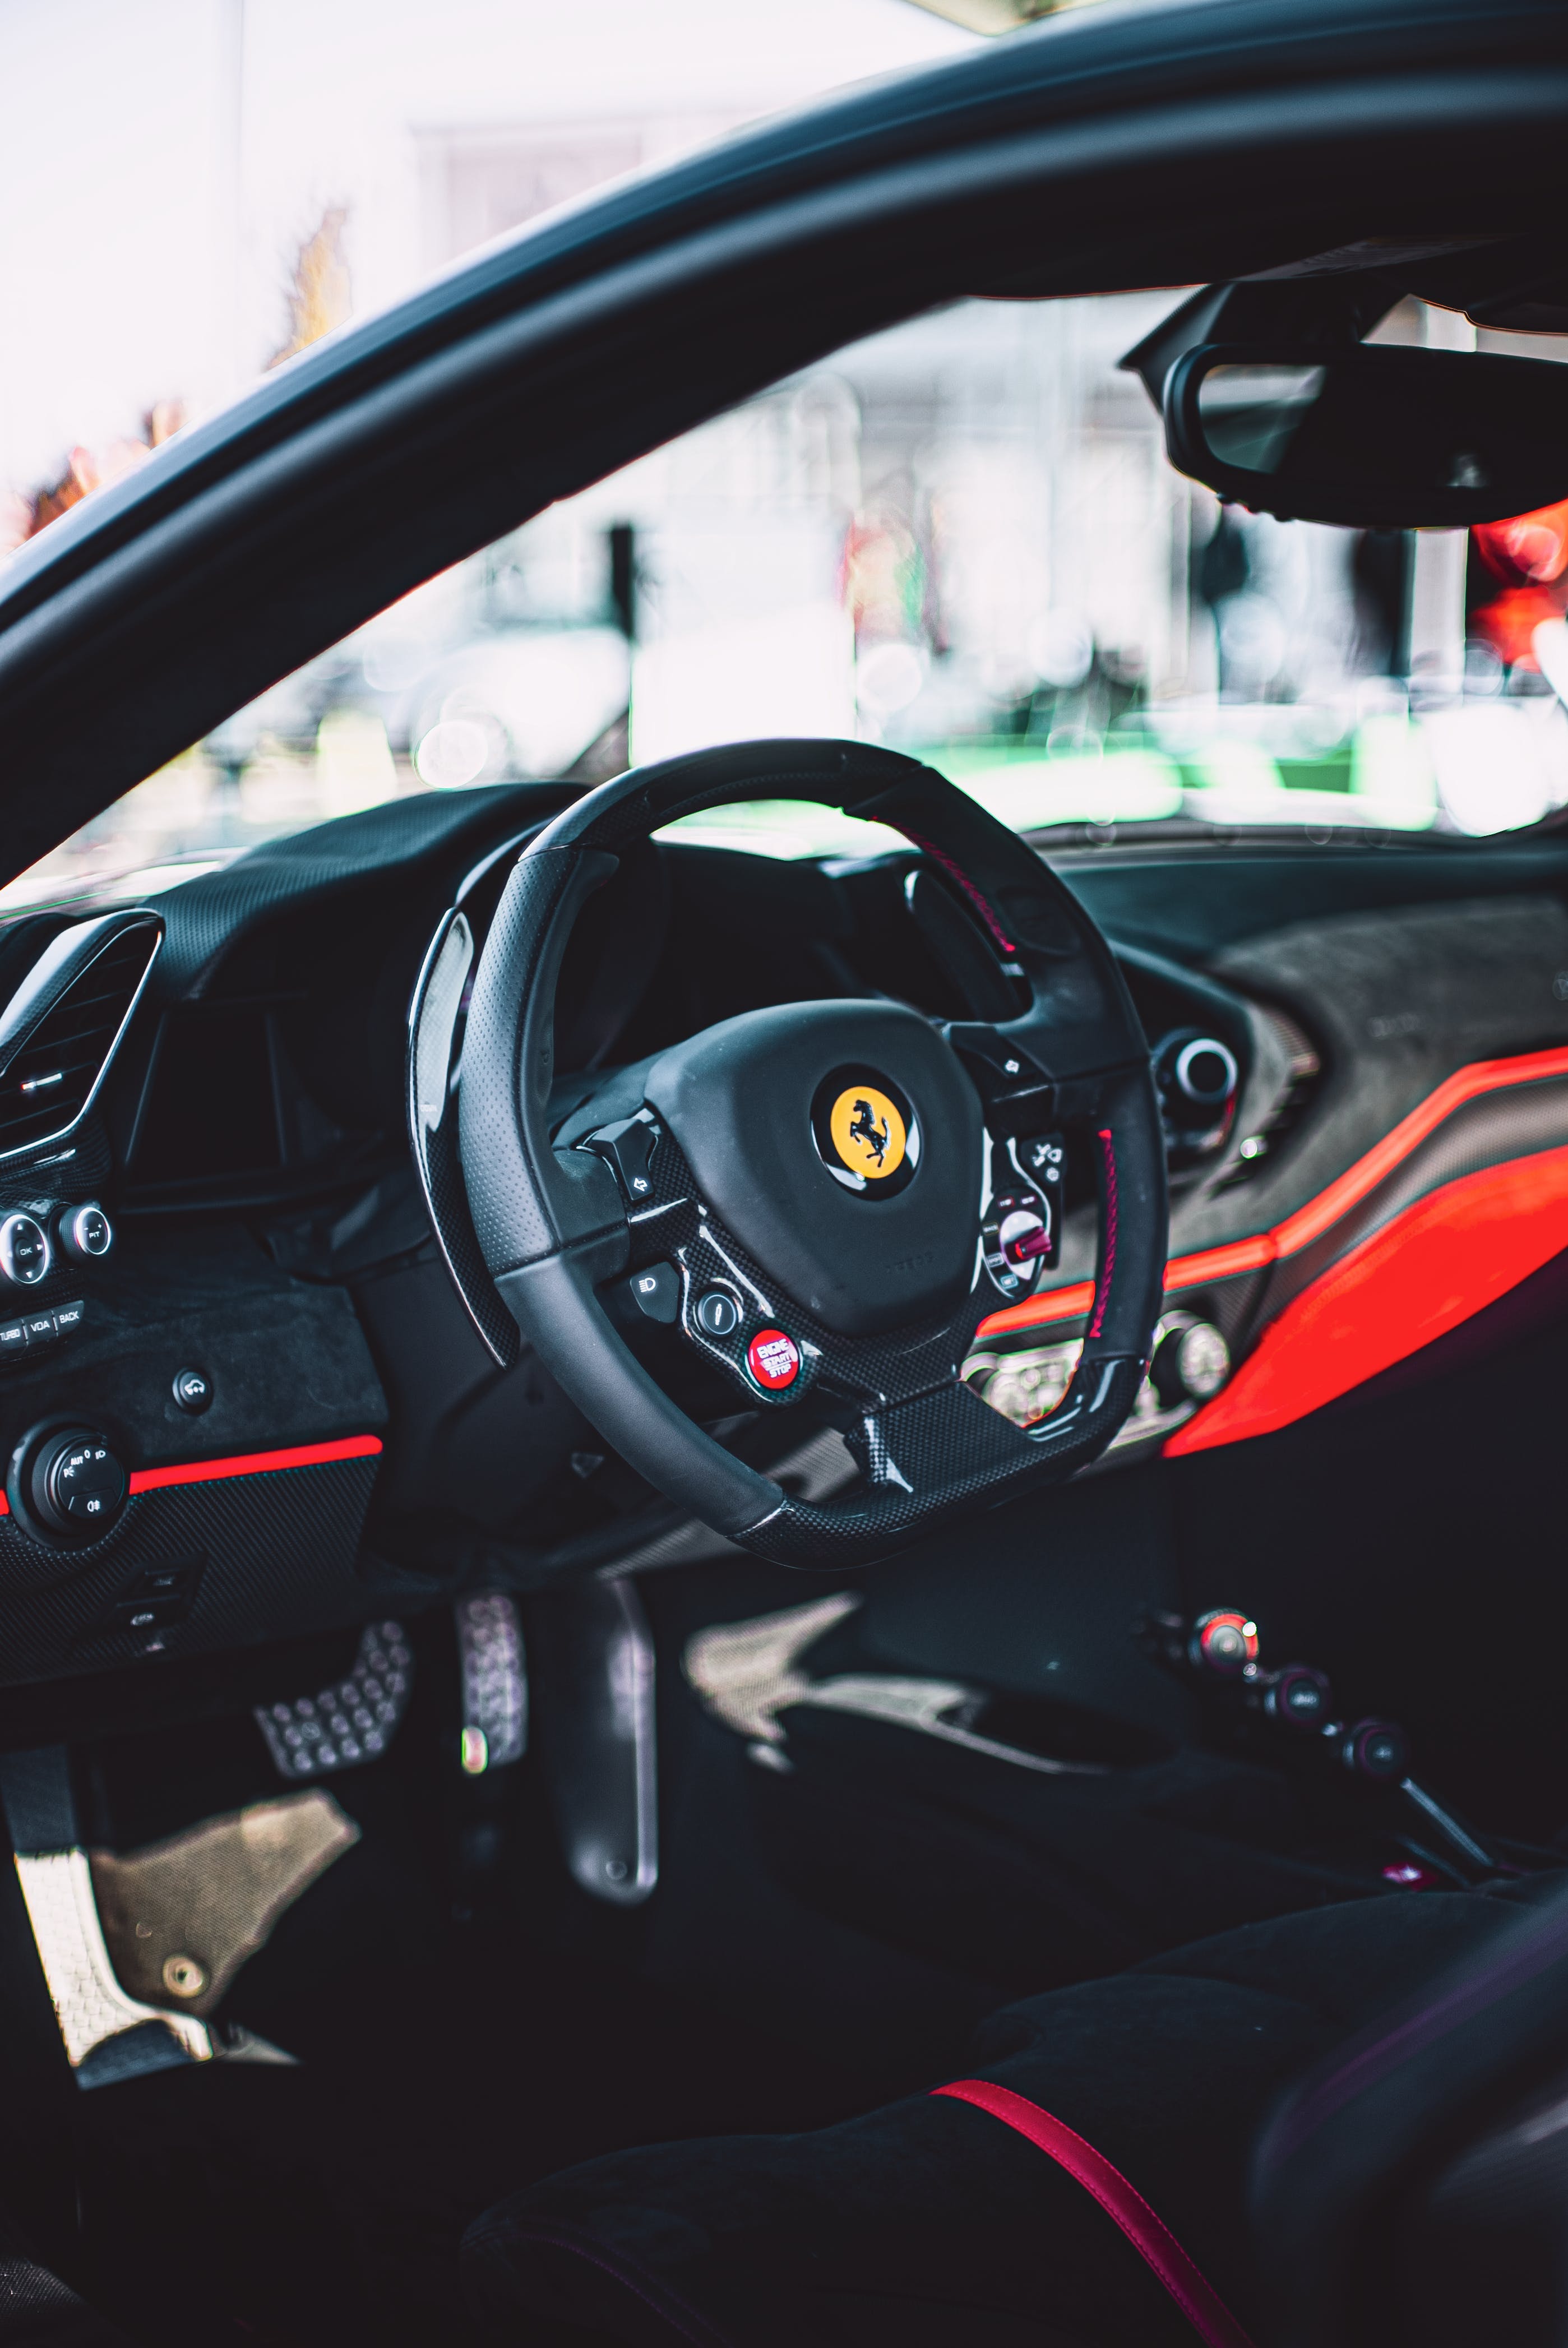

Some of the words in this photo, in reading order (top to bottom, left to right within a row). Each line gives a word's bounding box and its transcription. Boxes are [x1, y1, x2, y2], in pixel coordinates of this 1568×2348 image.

[20, 1247, 33, 1255] OK
[59, 1311, 79, 1324] BACK
[30, 1320, 50, 1332] VDA
[0, 1328, 21, 1341] TURBO
[757, 1338, 790, 1359] ENGINE
[762, 1352, 790, 1368] START
[769, 1363, 792, 1378] STOP
